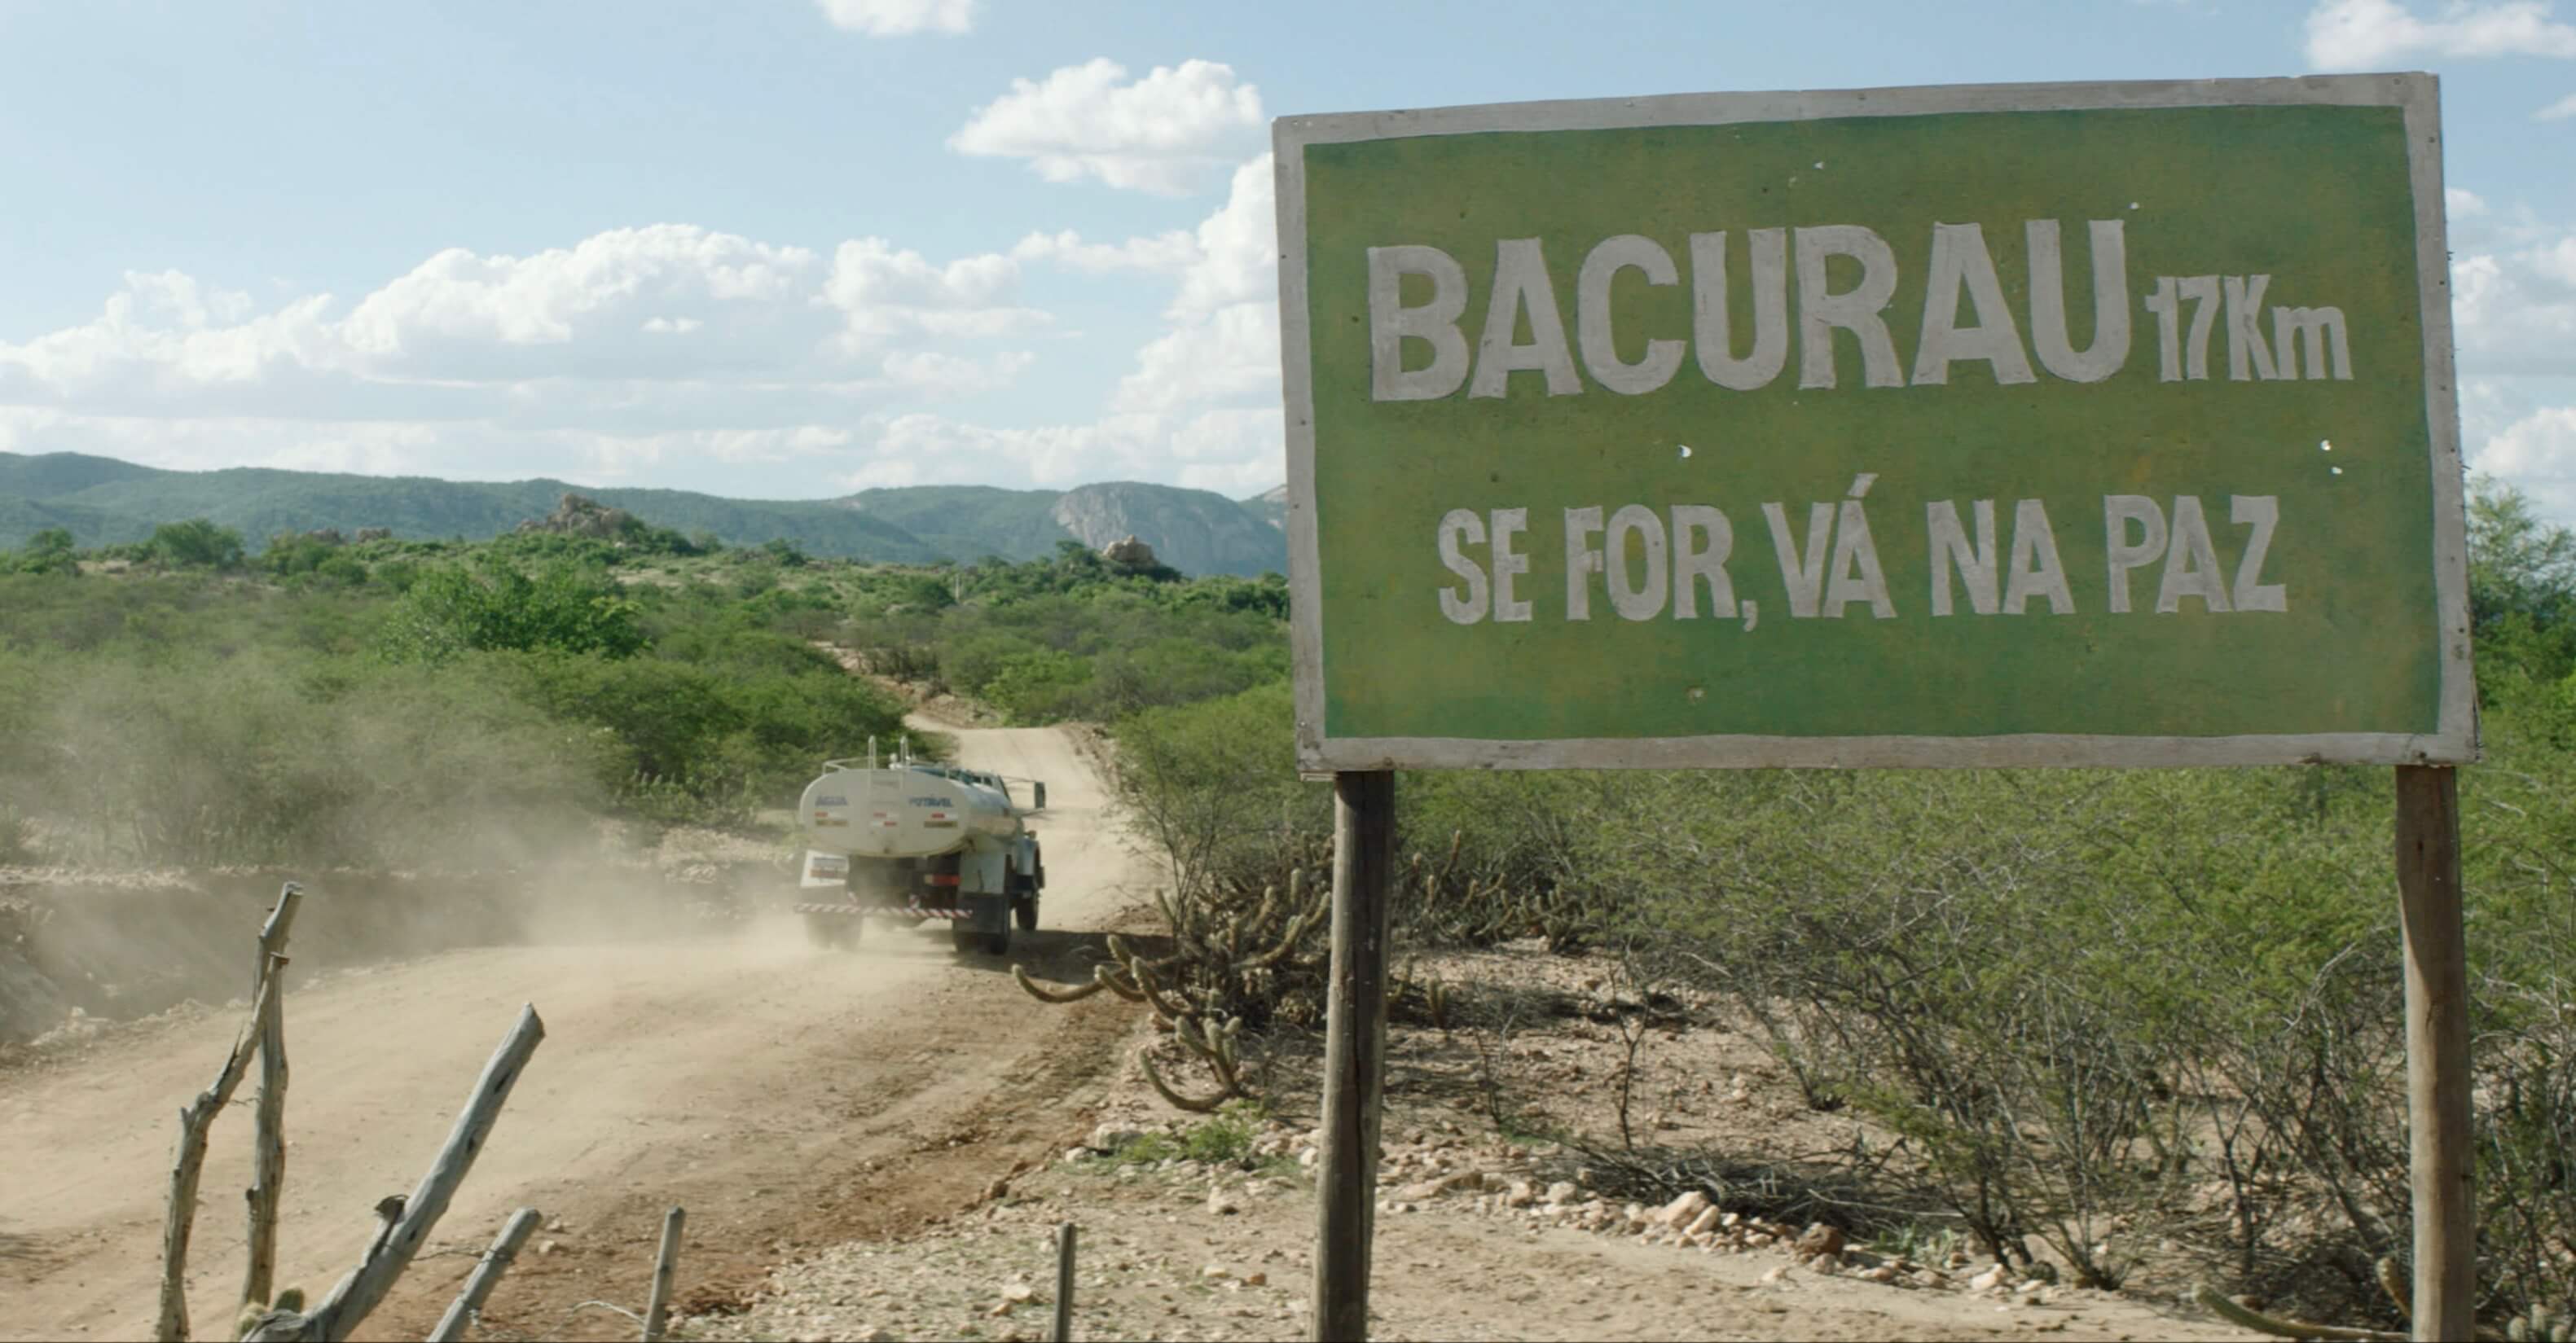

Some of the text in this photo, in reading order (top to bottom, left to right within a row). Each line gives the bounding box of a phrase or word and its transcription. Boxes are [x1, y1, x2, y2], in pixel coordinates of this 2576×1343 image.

[1368, 218, 2354, 402] BACURAU 17Km
[1437, 472, 2288, 633] SE FOR, VÁ NA PAZ
